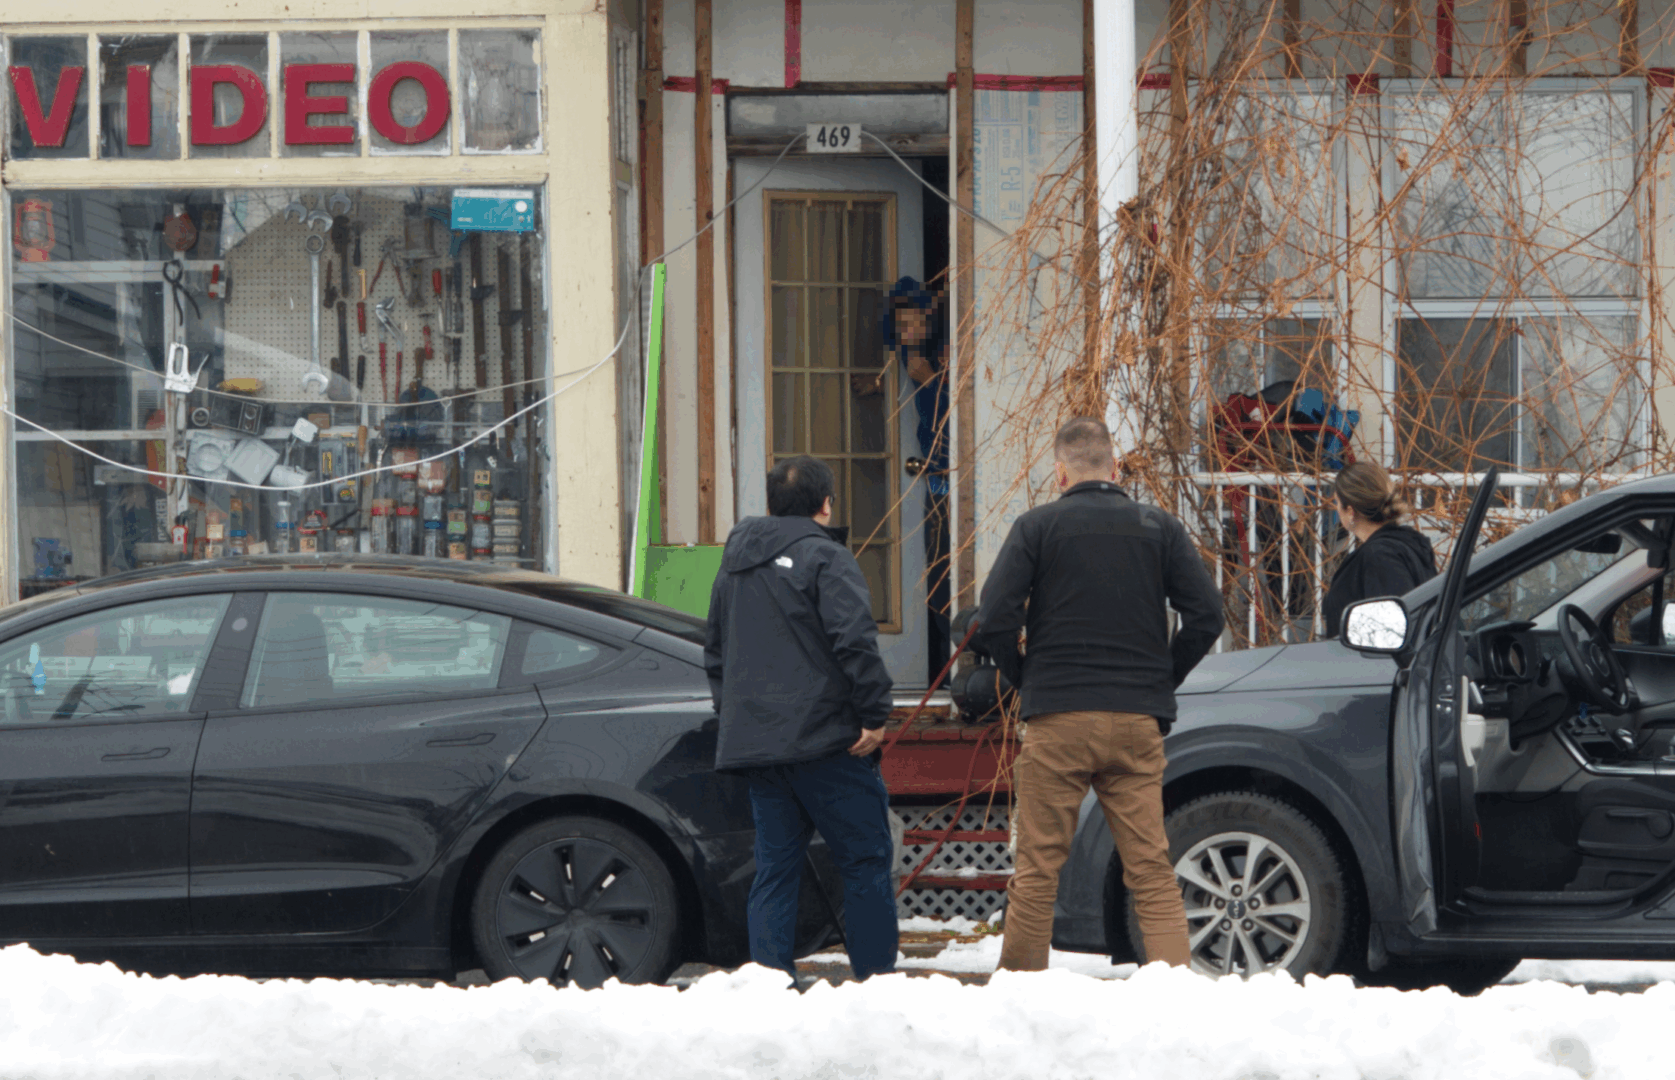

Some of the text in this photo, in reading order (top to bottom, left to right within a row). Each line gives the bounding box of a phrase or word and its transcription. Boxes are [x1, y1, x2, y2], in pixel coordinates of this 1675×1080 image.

[8, 61, 451, 147] VIDEO
[817, 126, 850, 147] 469
[1000, 167, 1021, 191] R-5
